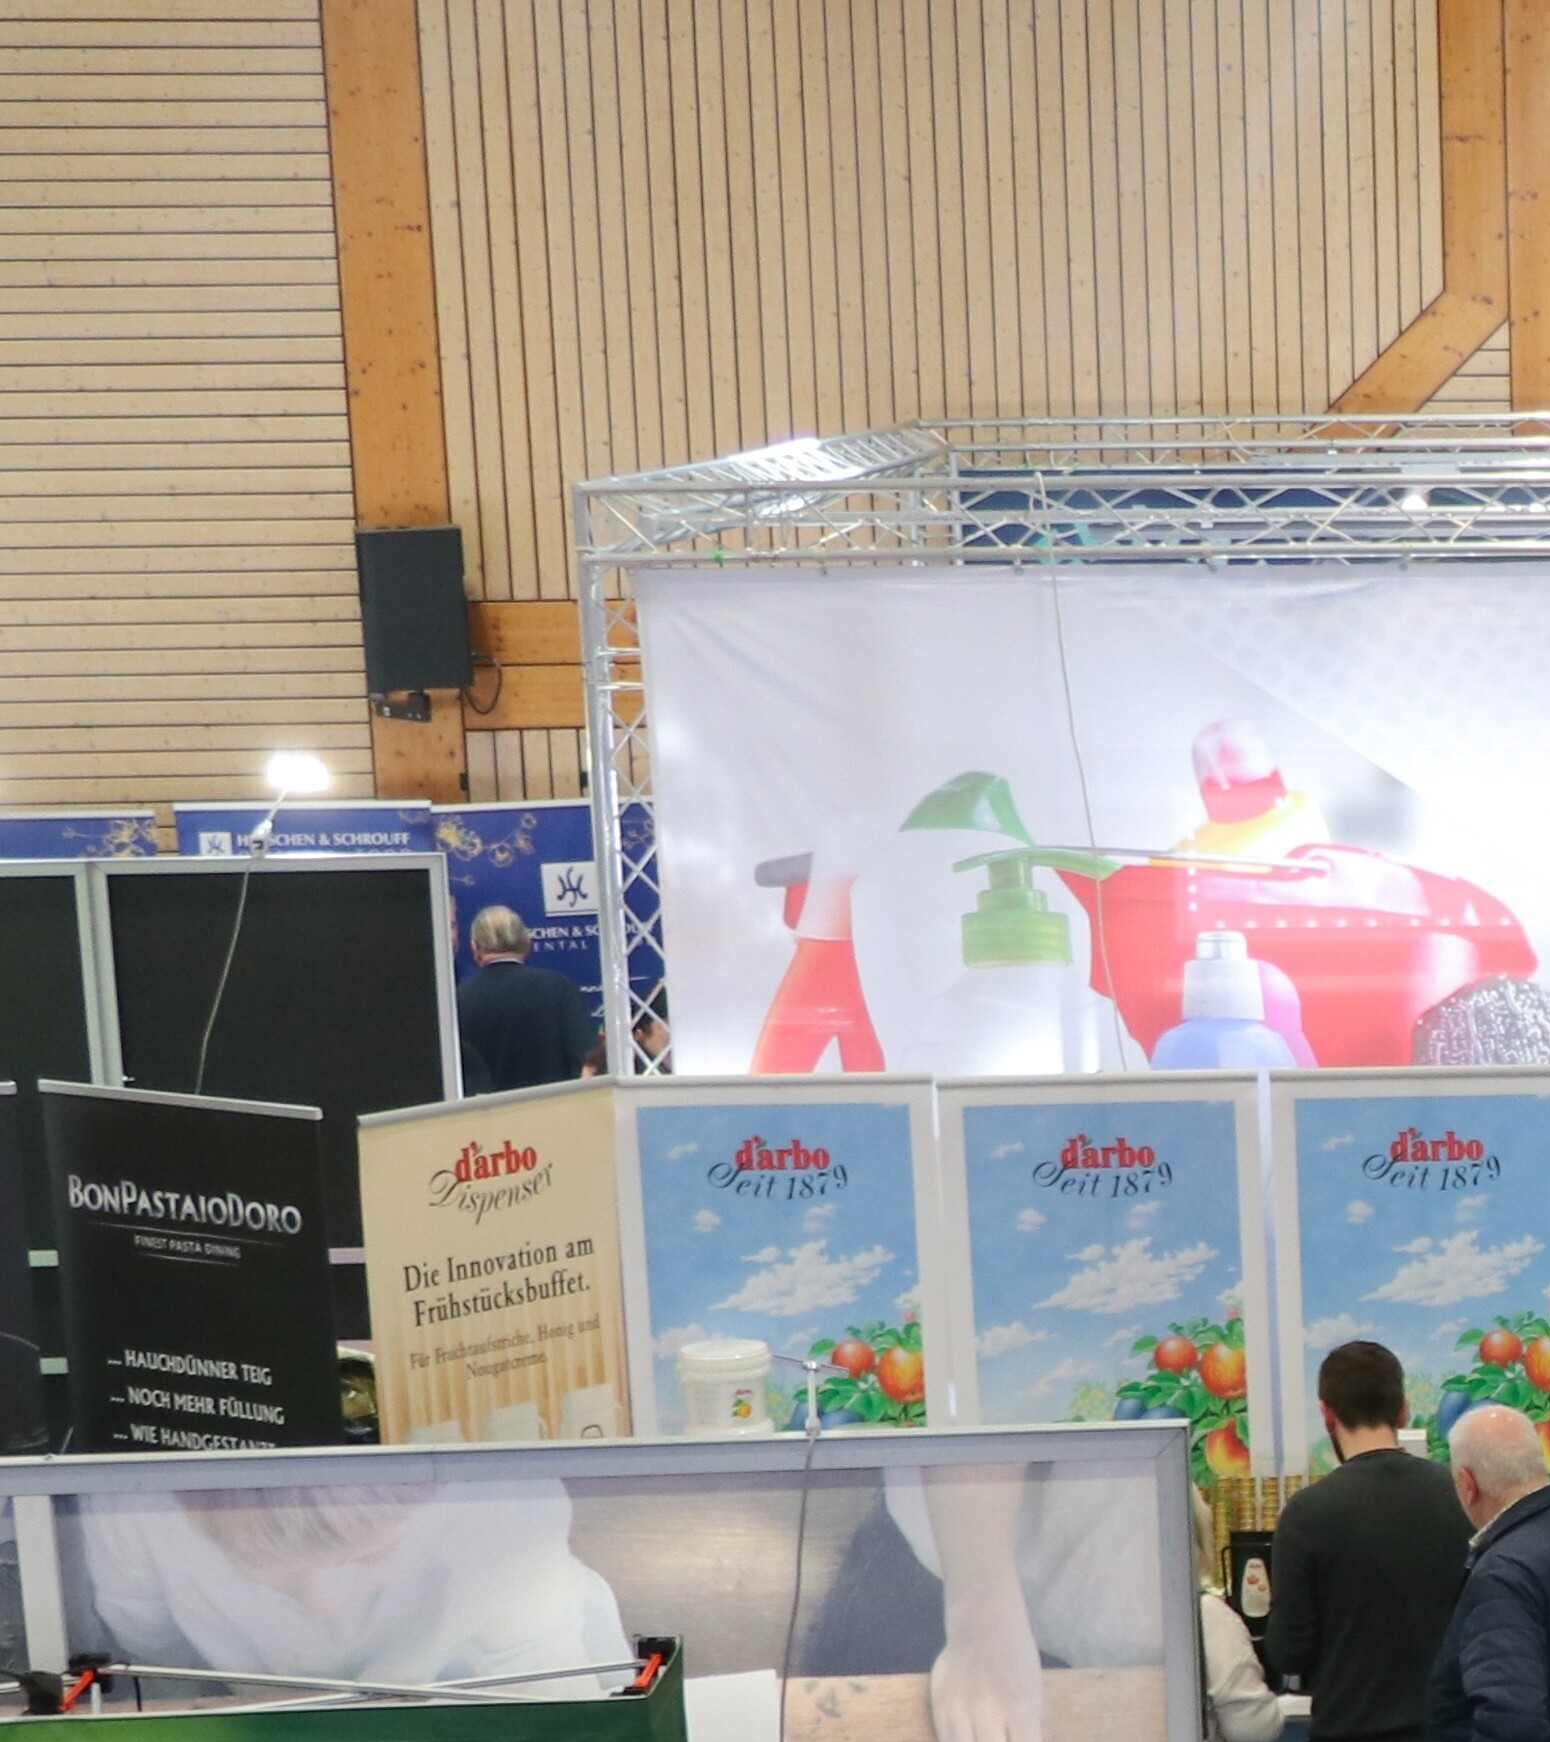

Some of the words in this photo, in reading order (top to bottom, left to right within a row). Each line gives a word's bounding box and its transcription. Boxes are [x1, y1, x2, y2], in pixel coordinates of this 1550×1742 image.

[319, 833, 331, 846] &
[706, 1161, 776, 1199] Seit
[786, 1164, 849, 1200] 1879
[1032, 1160, 1100, 1199] Seit
[1110, 1162, 1174, 1200] 1879
[1361, 1152, 1432, 1191] Seit
[1439, 1155, 1502, 1192] 1879
[428, 1163, 553, 1225] Dispenser
[134, 1234, 168, 1249] FINEST
[169, 1238, 203, 1253] PASTA
[204, 1242, 242, 1259] DINING
[403, 1262, 440, 1292] Die
[447, 1242, 558, 1282] Innovation
[565, 1238, 594, 1258] am
[413, 1268, 591, 1328] Frühstücksbuffet.
[410, 1351, 432, 1370] Für
[538, 1320, 575, 1343] Honig
[577, 1313, 601, 1333] und
[124, 1348, 239, 1381] HAUCHDÜNNER
[241, 1364, 273, 1386] TEIG
[127, 1386, 172, 1409] NOCH
[173, 1391, 217, 1415] MEHR
[219, 1395, 286, 1425] FÜLLUNG
[130, 1423, 158, 1445] WIE
